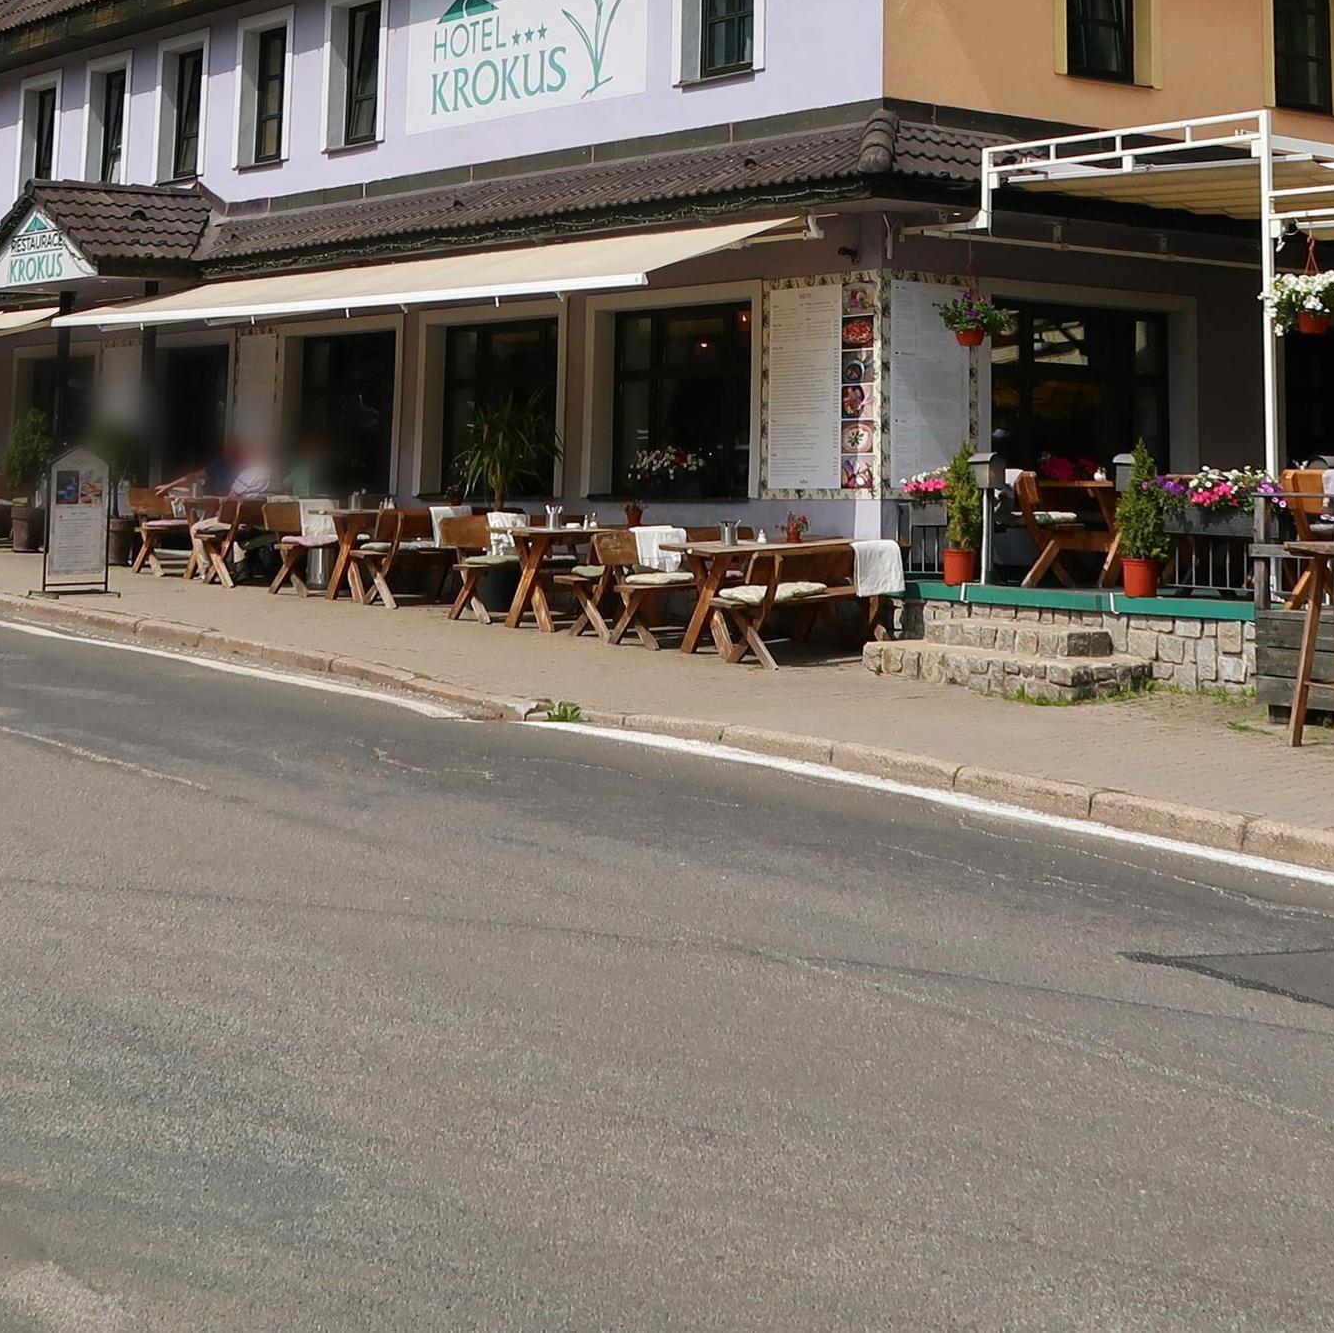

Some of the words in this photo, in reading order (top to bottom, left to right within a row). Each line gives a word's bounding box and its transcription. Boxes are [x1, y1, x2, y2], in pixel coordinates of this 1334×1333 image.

[433, 15, 507, 63] HOTEL
[430, 45, 567, 115] KROKUS
[11, 232, 63, 253] RESTAURACE
[9, 252, 63, 283] KROKUS
